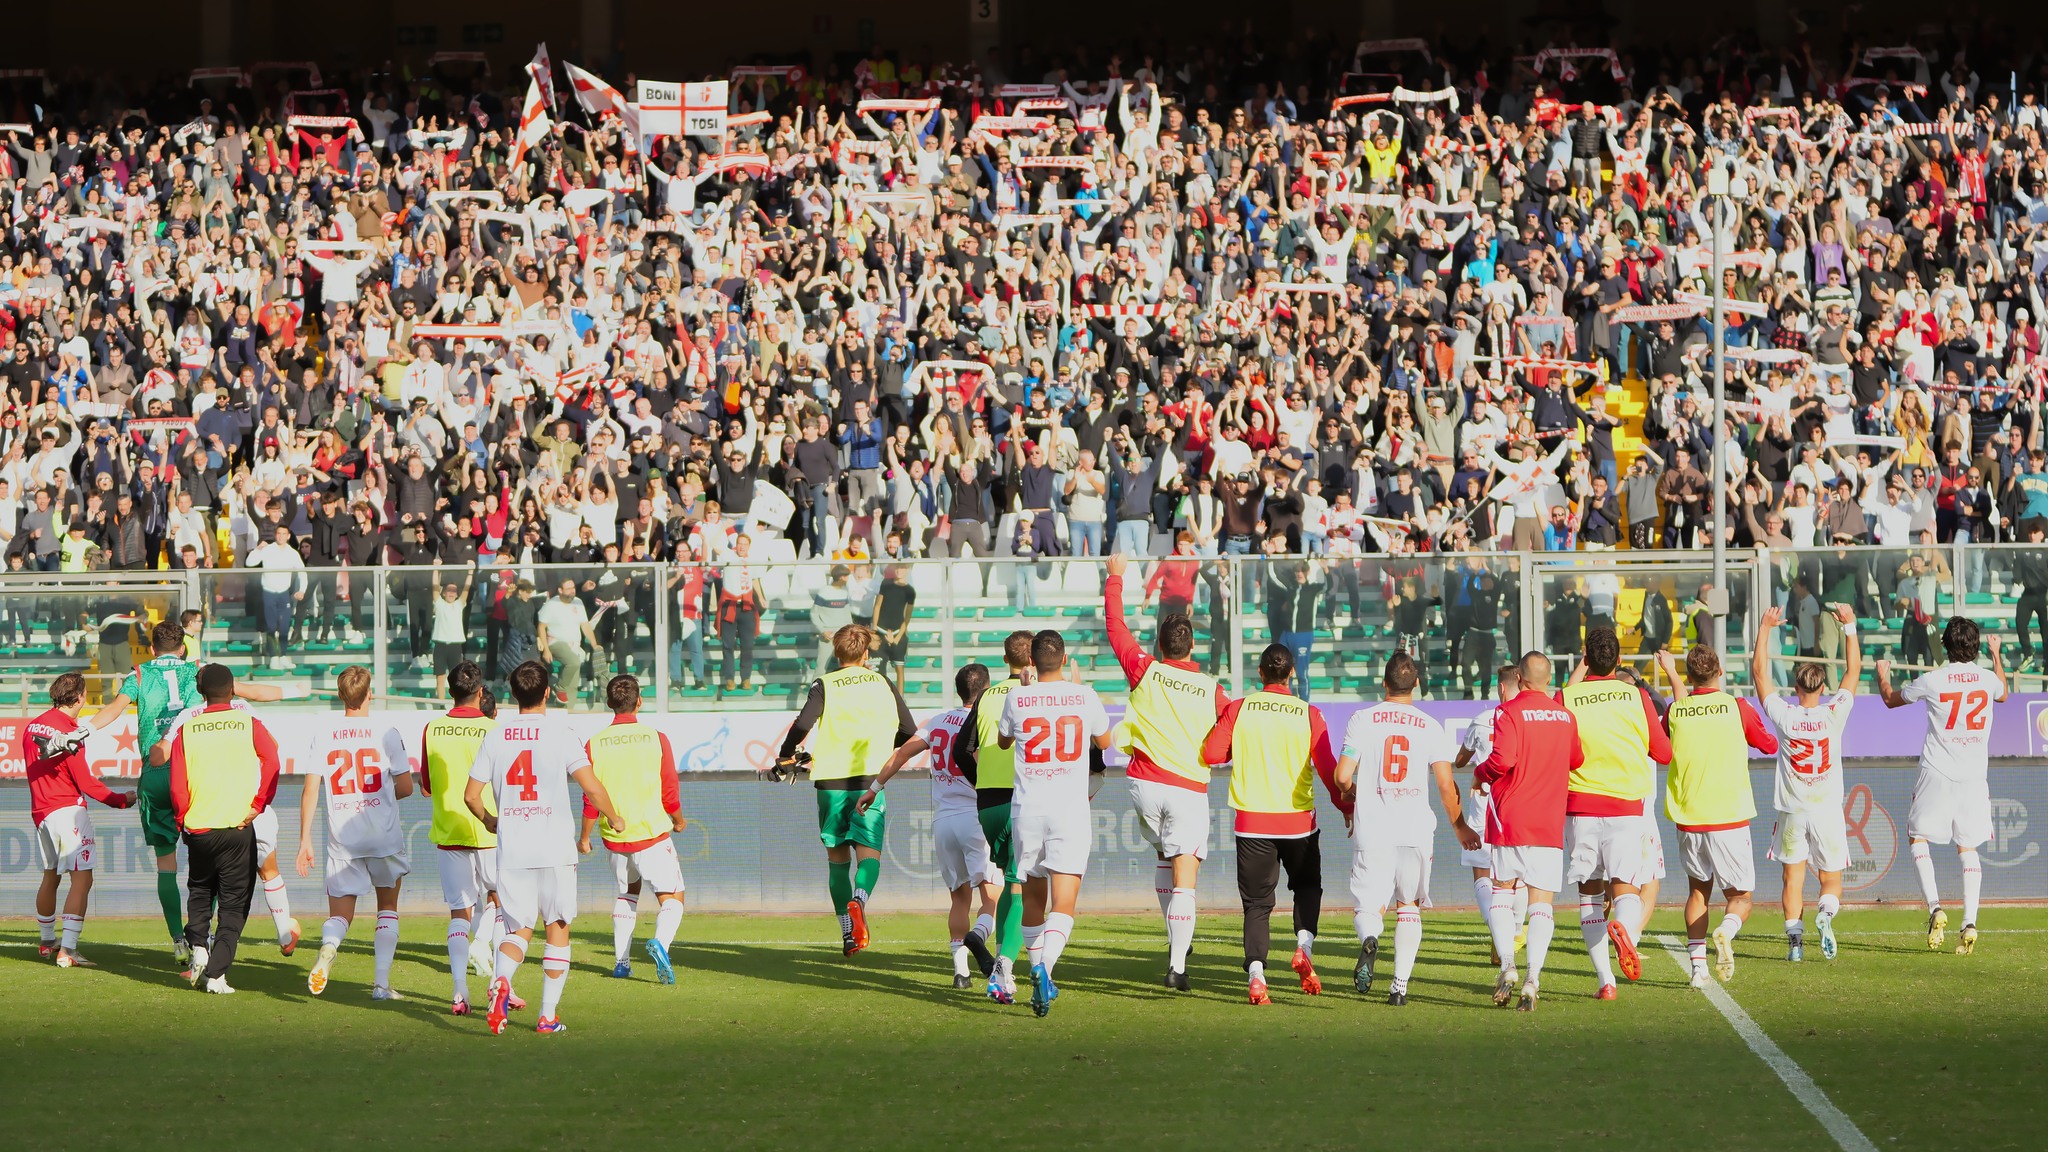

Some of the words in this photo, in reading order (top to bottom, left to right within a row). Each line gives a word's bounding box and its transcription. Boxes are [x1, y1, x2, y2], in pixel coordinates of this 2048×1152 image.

[646, 88, 676, 100] BONI
[691, 118, 718, 129] TOSI
[833, 674, 880, 688] macron
[1152, 671, 1206, 698] macron
[163, 670, 184, 711] 1
[1017, 695, 1086, 708] BORTOLUSSI
[1574, 691, 1632, 707] macron
[1247, 701, 1304, 716] macron
[1675, 704, 1729, 718] macron
[1940, 690, 1988, 730] 72
[1373, 711, 1426, 729] CRISETIG
[1522, 709, 1571, 724] macron
[192, 720, 245, 733] macron
[433, 725, 487, 738] macron
[332, 728, 372, 741] KIRWAN
[504, 728, 540, 741] BELLI
[600, 733, 651, 748] macron
[1022, 715, 1083, 764] 20
[1382, 735, 1410, 783] 6
[1789, 737, 1832, 774] 21
[327, 748, 382, 796] 26
[505, 749, 538, 802] 4
